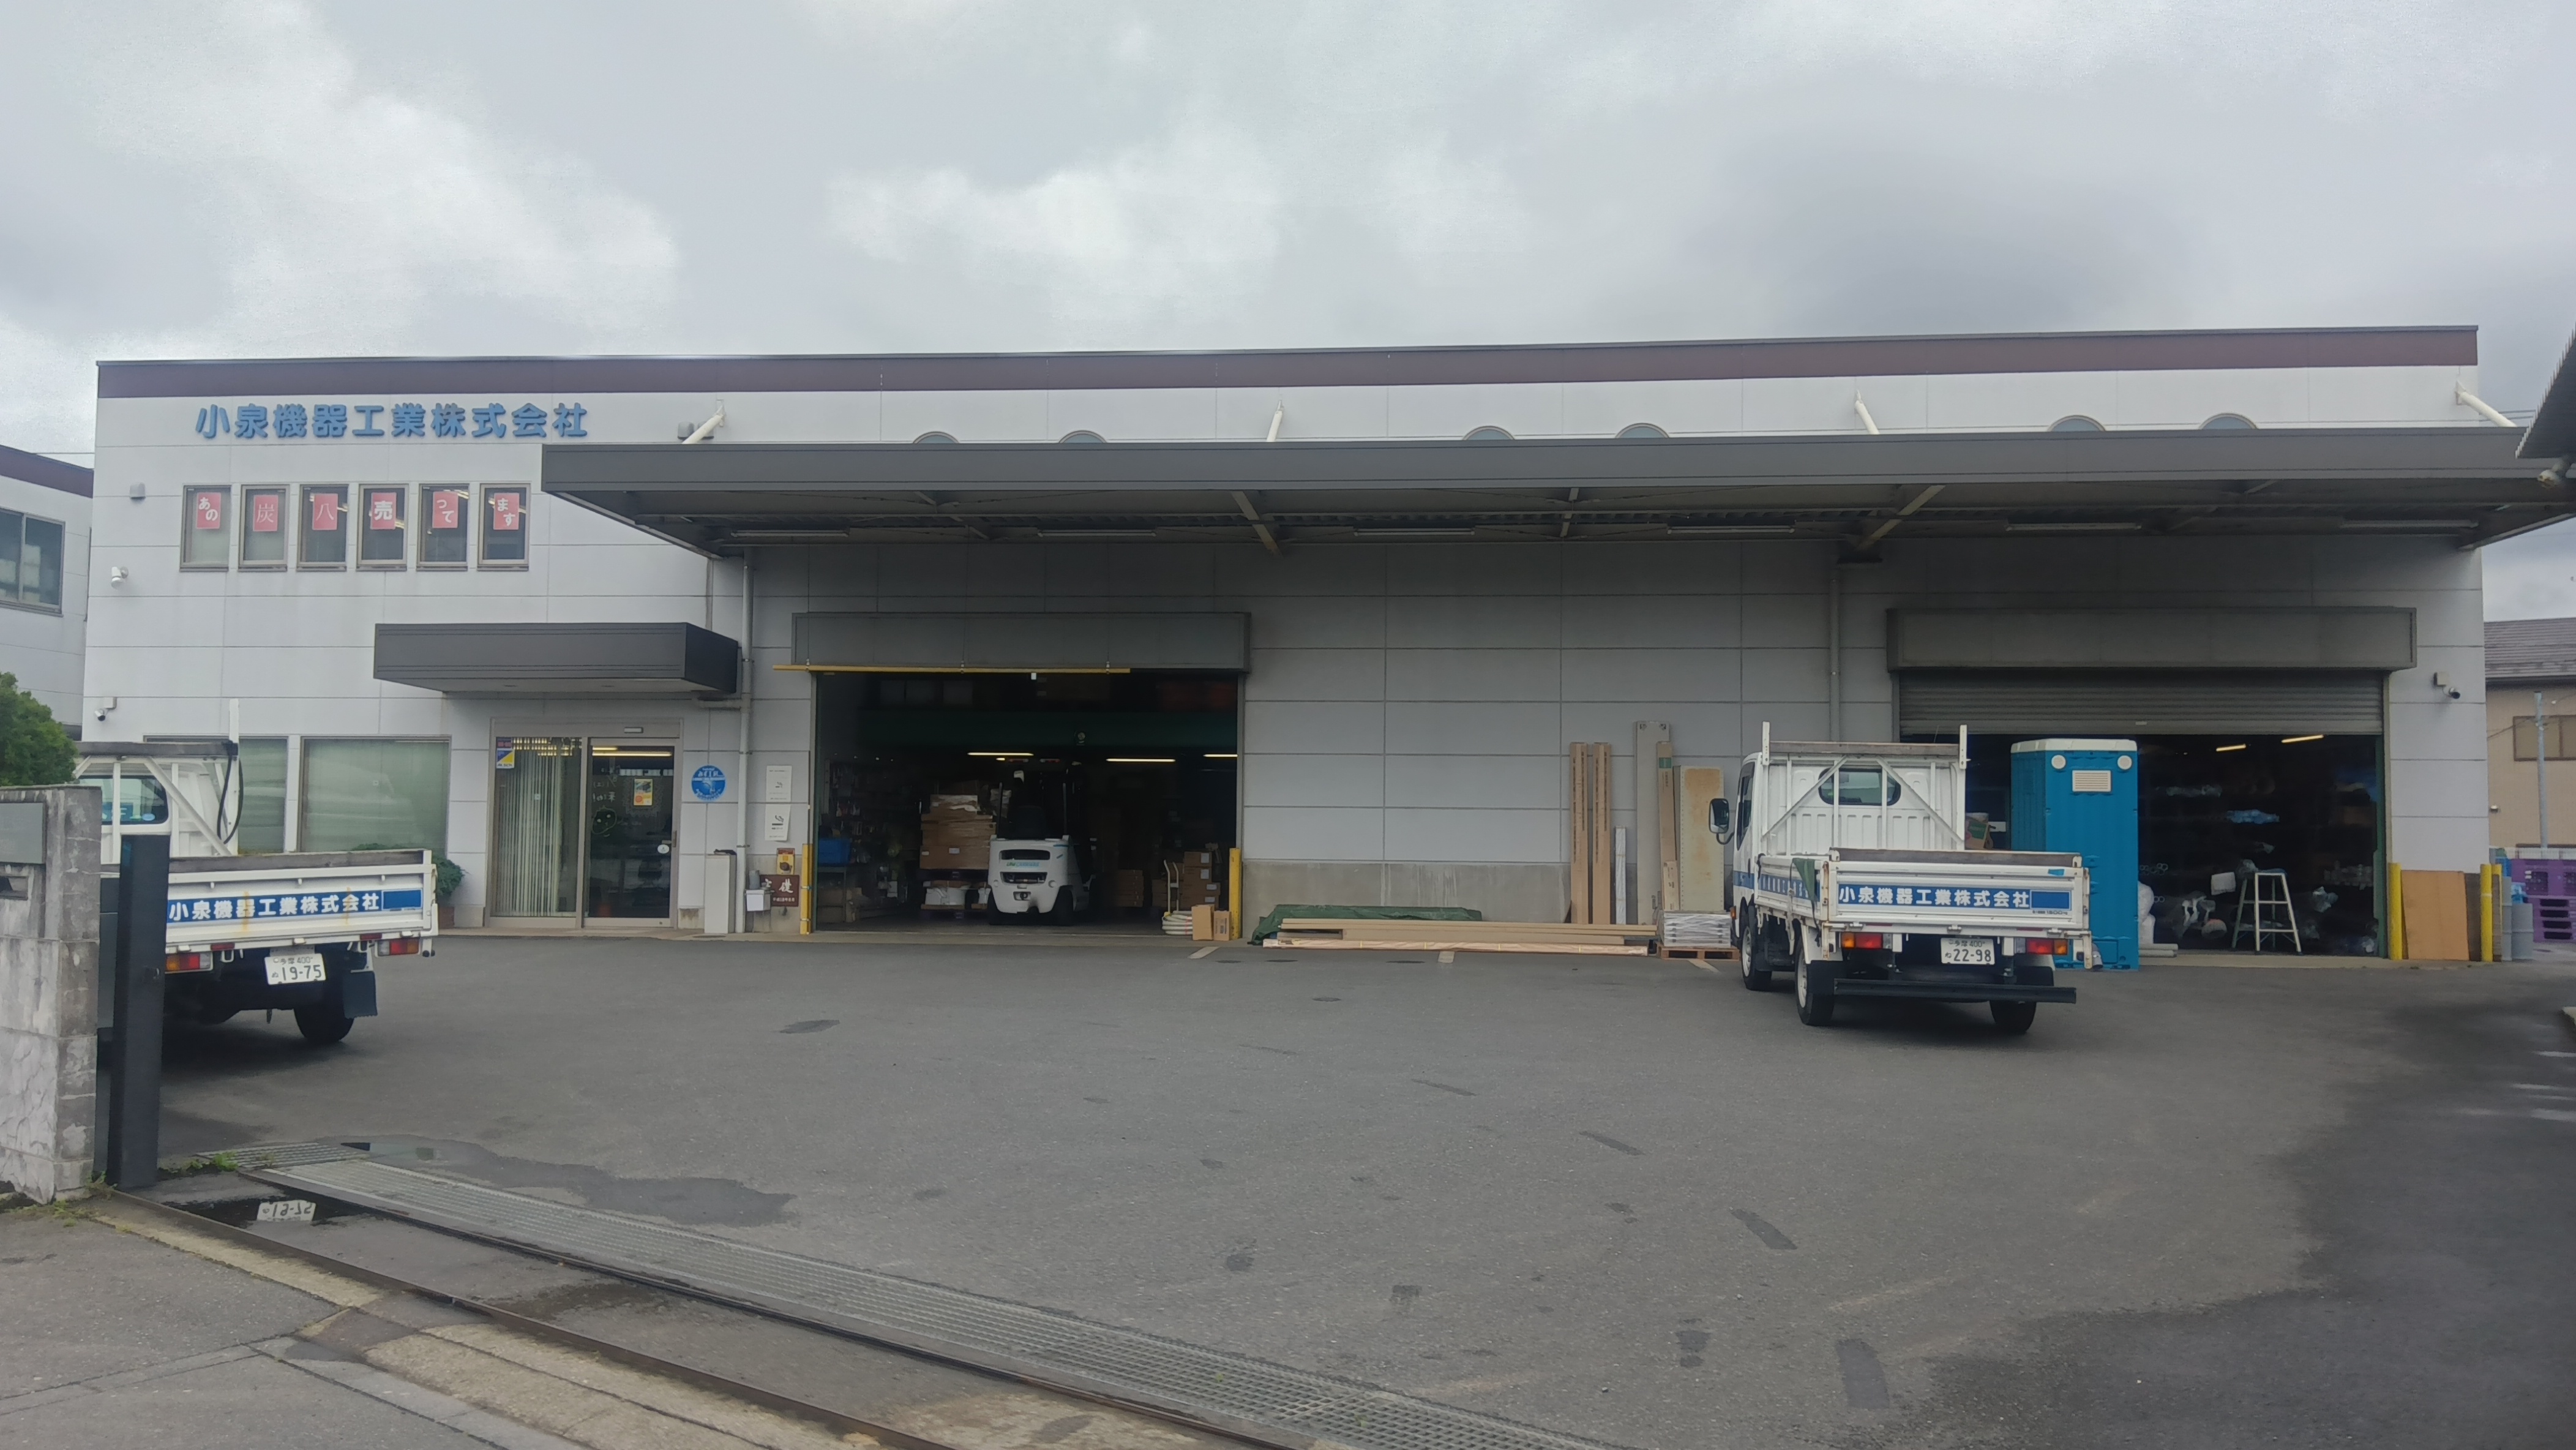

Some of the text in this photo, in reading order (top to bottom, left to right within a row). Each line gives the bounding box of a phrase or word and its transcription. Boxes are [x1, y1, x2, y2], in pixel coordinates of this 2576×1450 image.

[196, 403, 588, 438] 小泉機器工業株式会社
[198, 497, 516, 527] あの 炭 八 売 って ます
[169, 893, 380, 921] 小泉機器工業株式会社
[1838, 886, 2029, 908] 小泉機器工業株式会社
[1953, 948, 1991, 962] 22-98
[282, 964, 322, 981] 19-75
